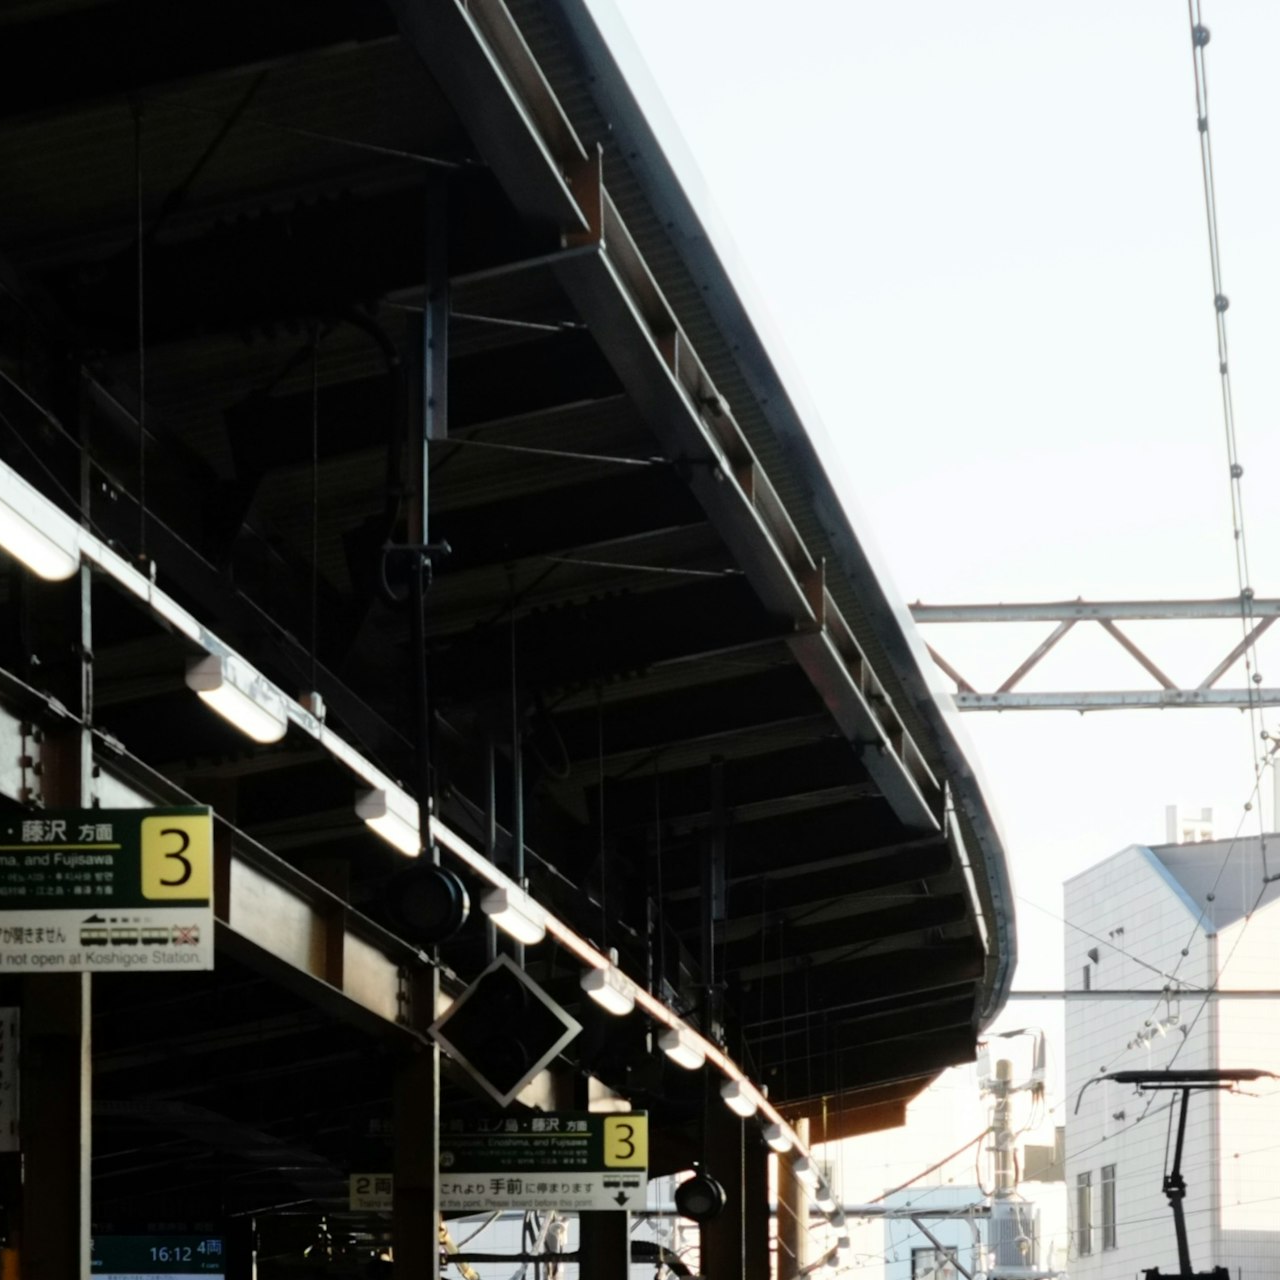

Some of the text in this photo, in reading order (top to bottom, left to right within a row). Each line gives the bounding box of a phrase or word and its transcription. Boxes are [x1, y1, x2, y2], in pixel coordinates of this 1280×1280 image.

[78, 823, 113, 842] 方面
[24, 853, 49, 867] and
[53, 852, 114, 869] Fujisawa
[159, 828, 192, 886] 3
[6, 952, 27, 966] not
[31, 953, 65, 969] open
[69, 952, 82, 965] at
[86, 951, 148, 968] Koshigoe
[152, 950, 201, 965] Station.
[614, 1123, 636, 1160] 3
[355, 1177, 393, 1195] 2両
[149, 1246, 193, 1263] 16:12
[196, 1238, 223, 1256] 4両
